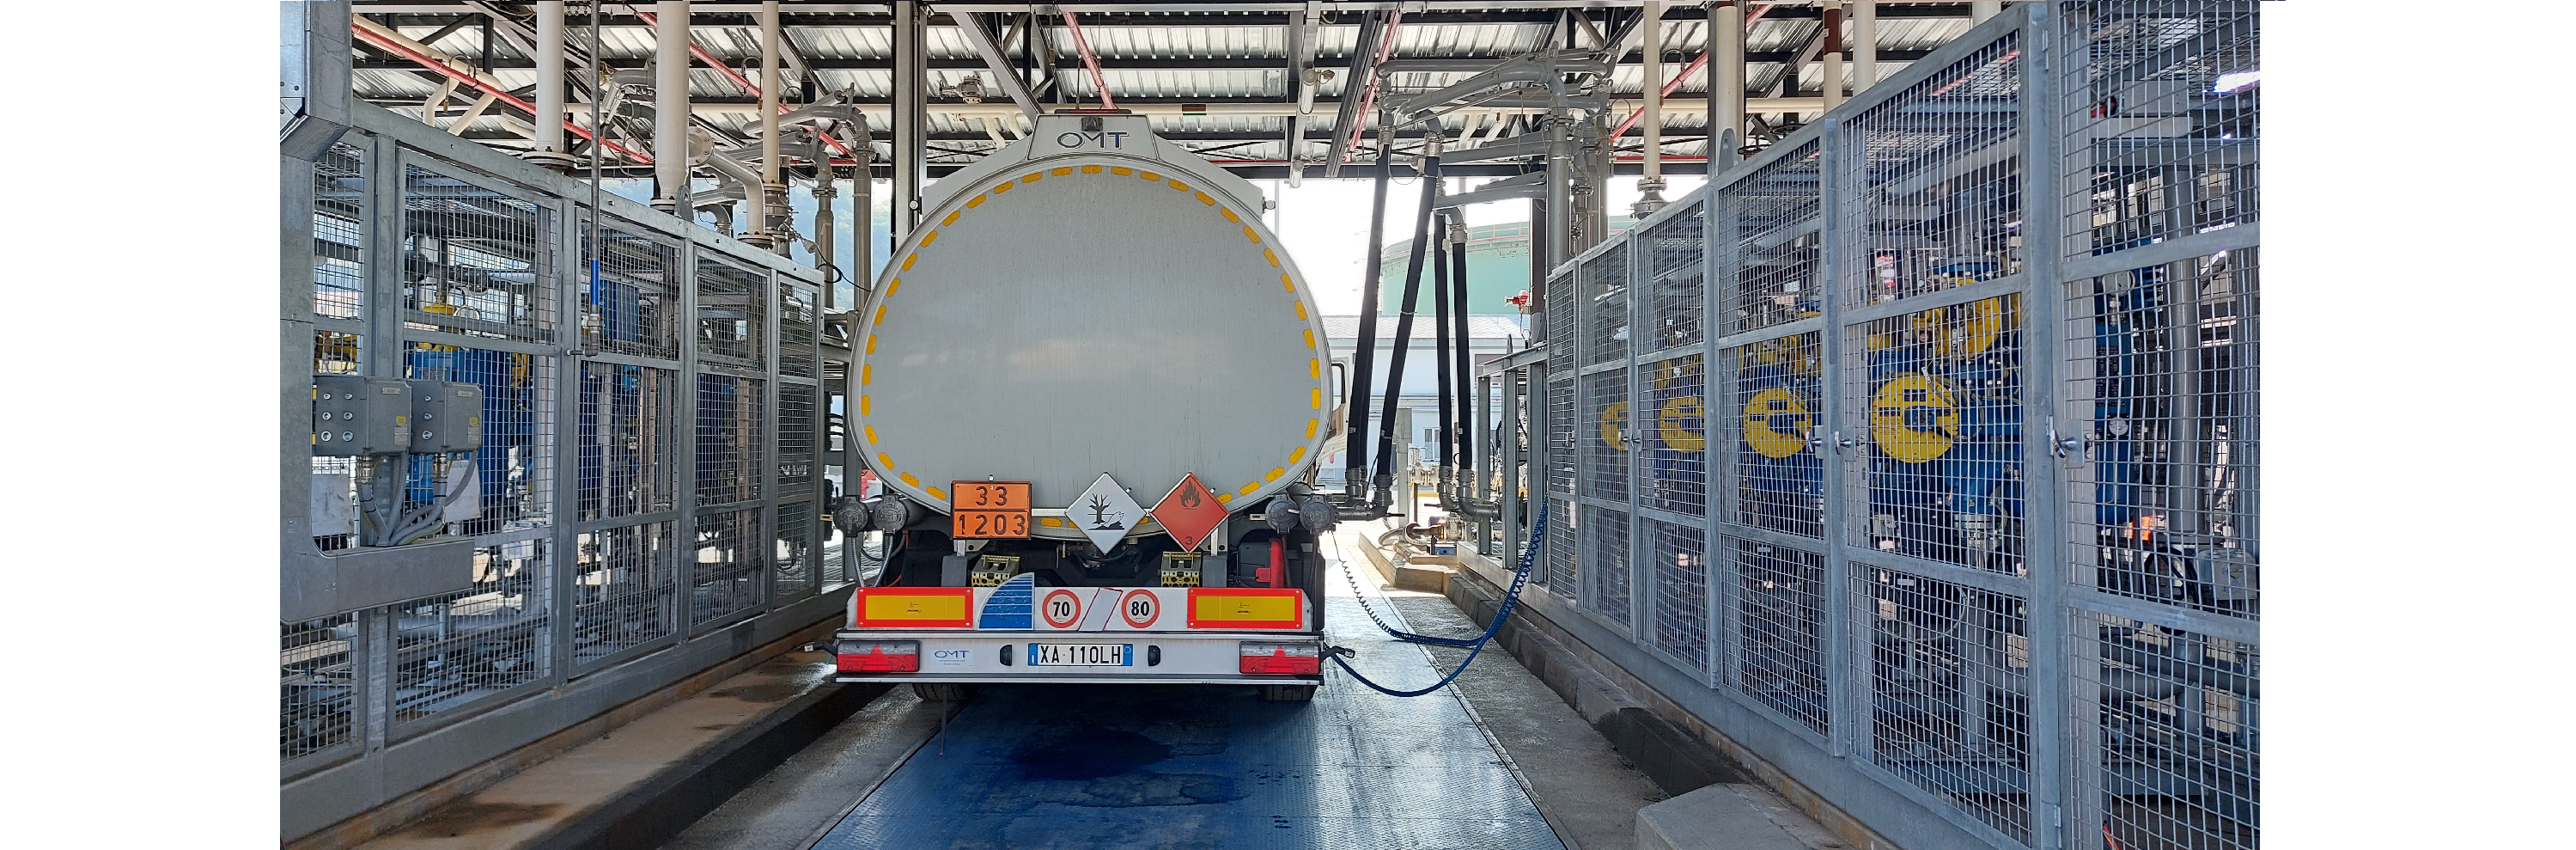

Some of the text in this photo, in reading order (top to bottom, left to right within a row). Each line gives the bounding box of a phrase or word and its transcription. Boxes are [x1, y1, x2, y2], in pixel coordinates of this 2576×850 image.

[1057, 131, 1128, 149] OMT
[975, 486, 1008, 506] 33
[959, 514, 1026, 535] 1203
[1184, 535, 1193, 546] 3
[1052, 601, 1070, 617] 70
[1130, 601, 1150, 616] 80
[935, 650, 971, 658] OMT
[1040, 645, 1121, 663] XA 110LH
